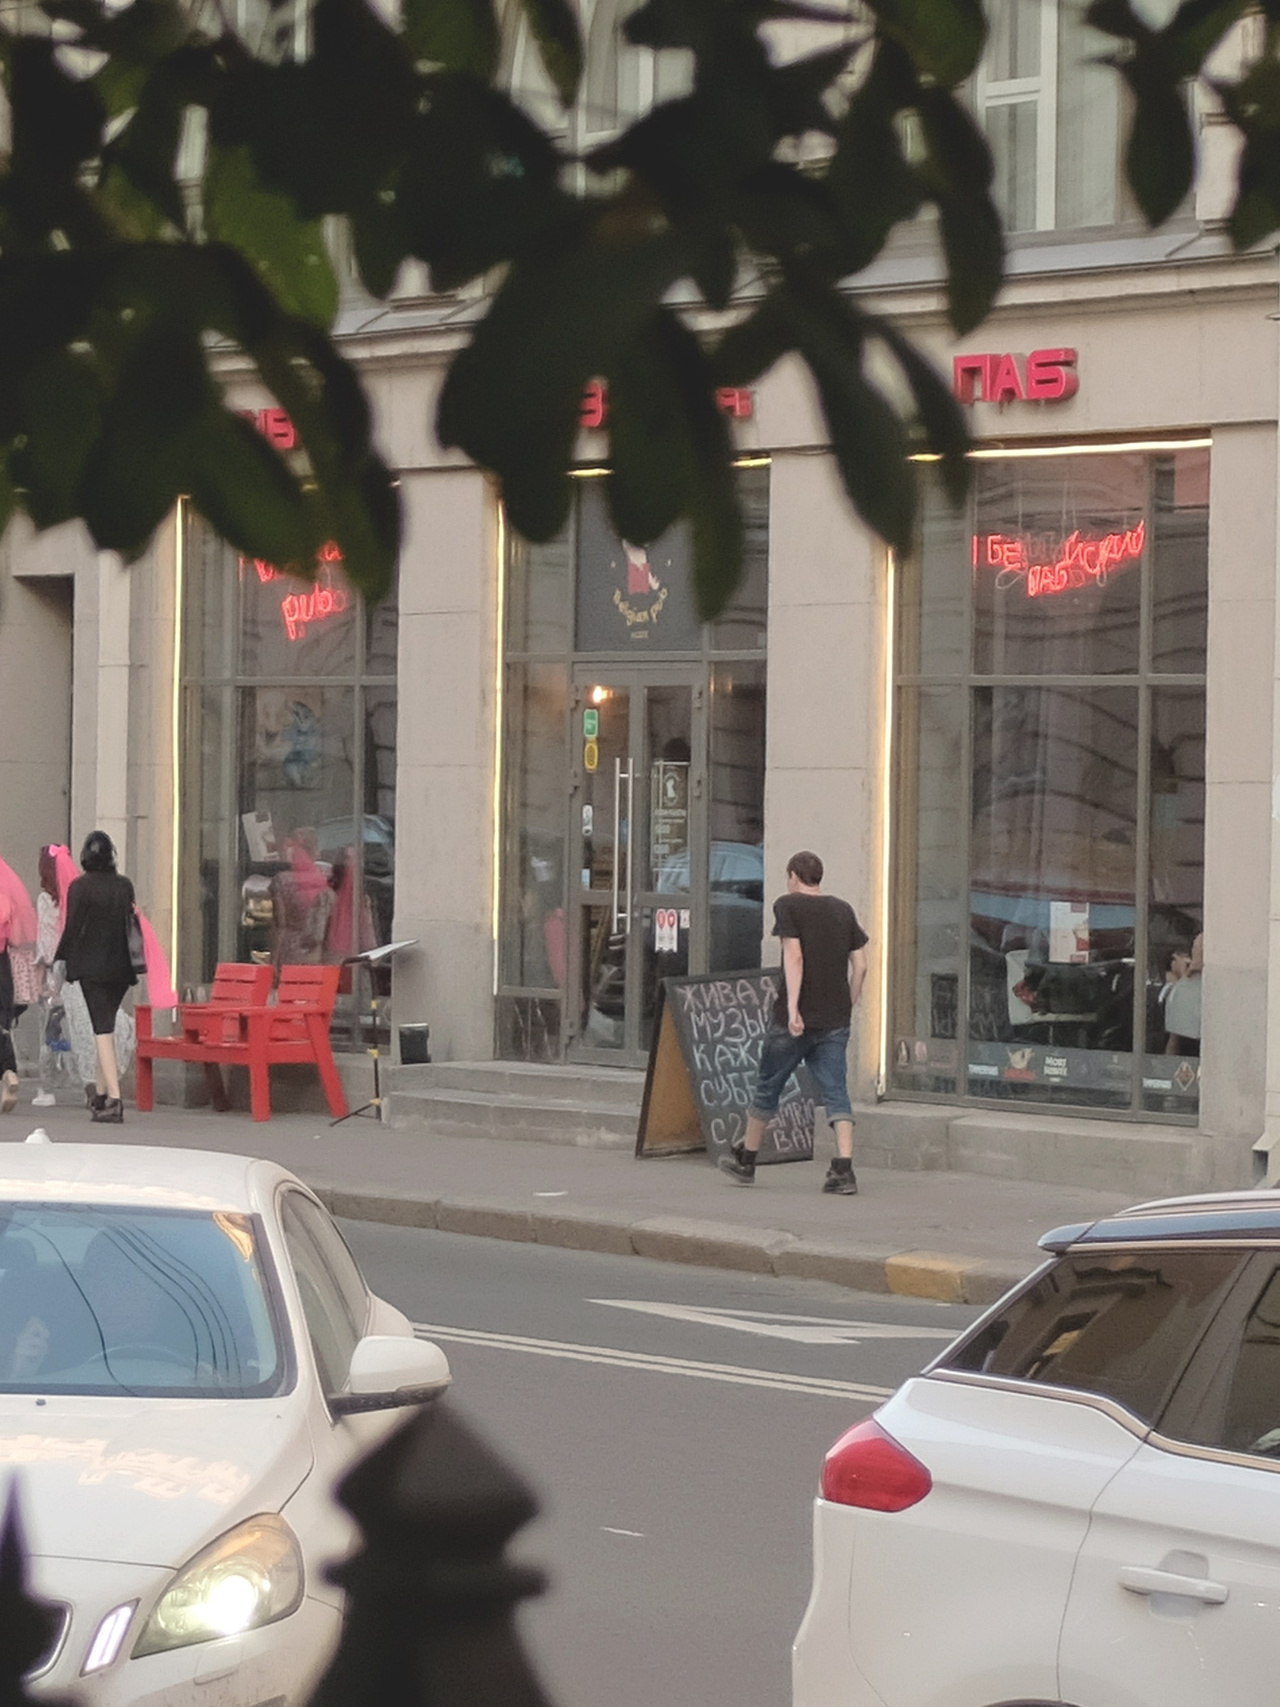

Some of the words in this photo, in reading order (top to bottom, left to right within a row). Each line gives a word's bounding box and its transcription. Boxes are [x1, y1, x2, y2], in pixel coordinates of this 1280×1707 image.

[953, 348, 1079, 402] ПАБ
[282, 582, 333, 640] pub
[676, 976, 779, 1012] ЖИВАЯ
[690, 1007, 767, 1042] МУЗЫ
